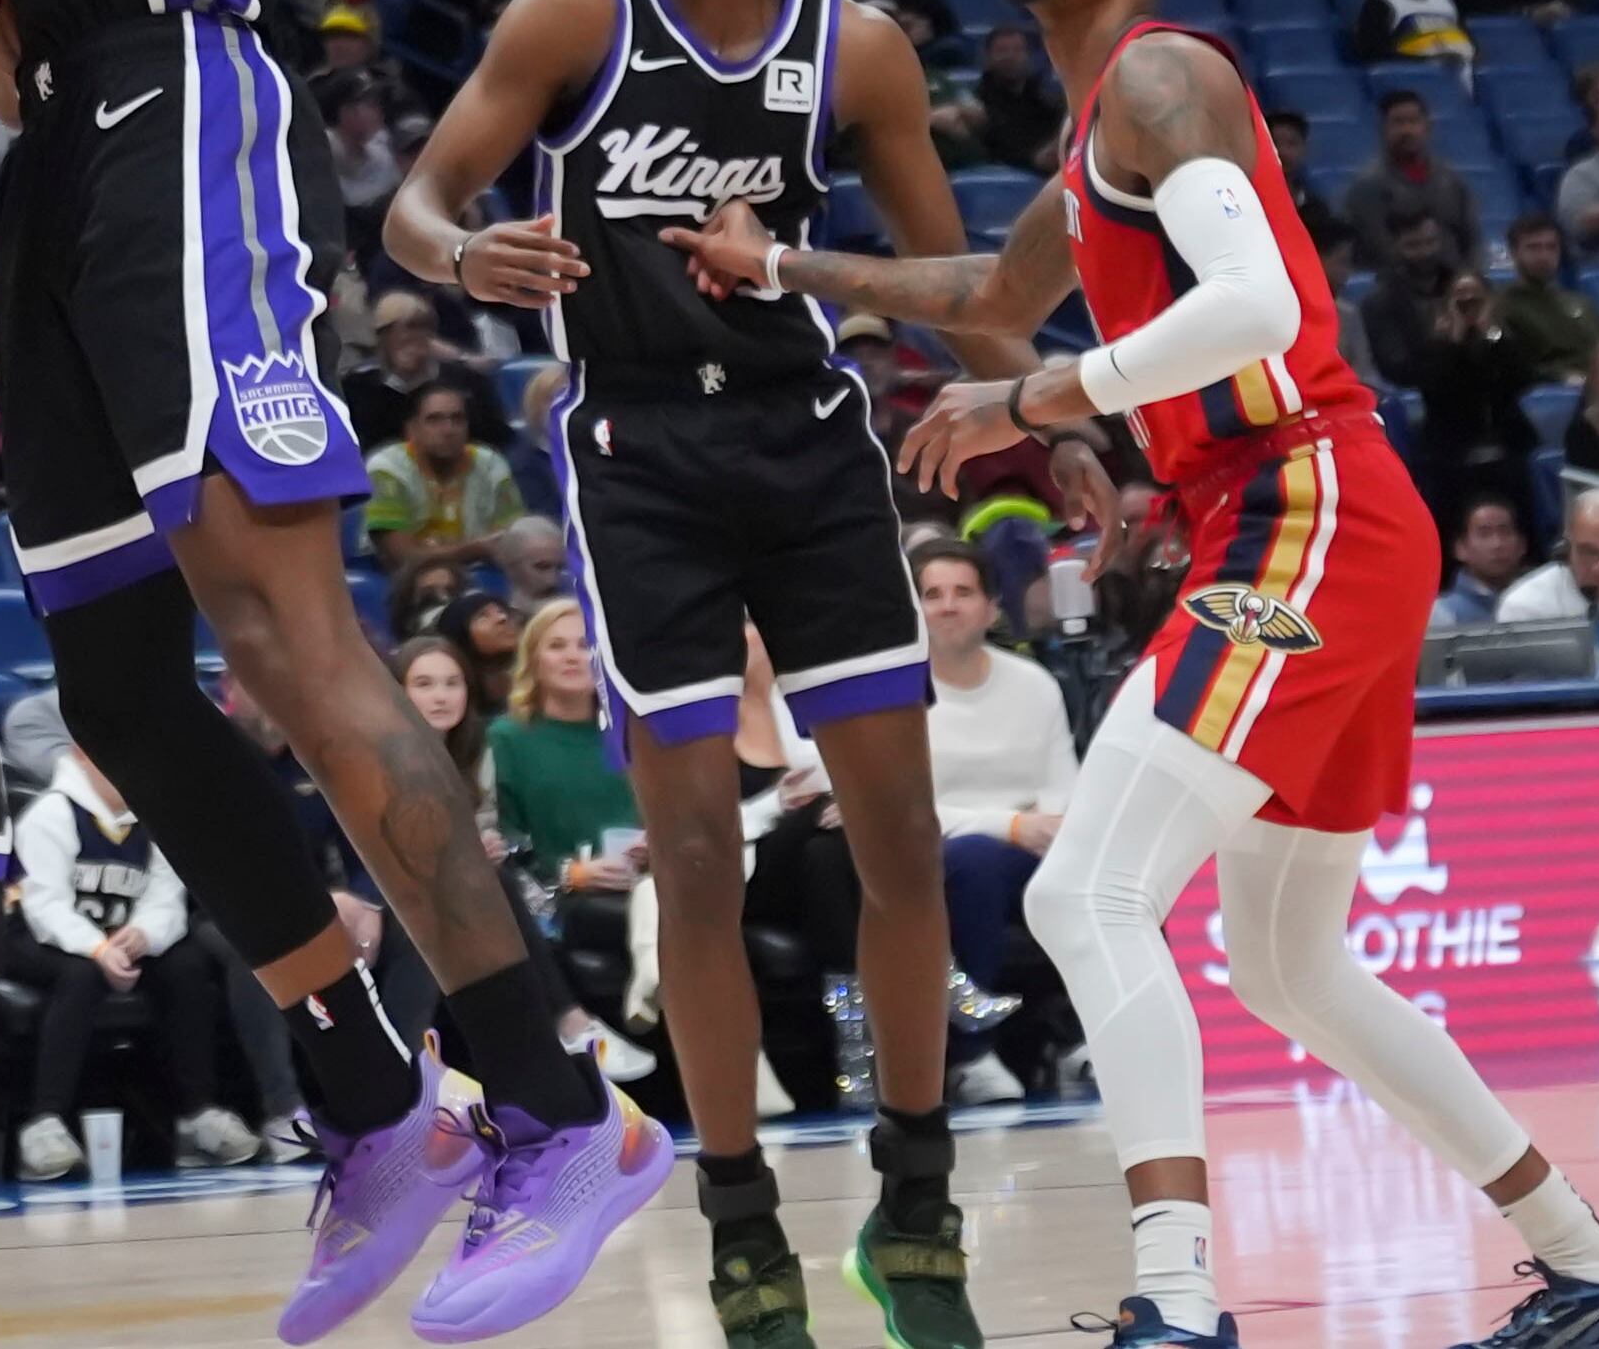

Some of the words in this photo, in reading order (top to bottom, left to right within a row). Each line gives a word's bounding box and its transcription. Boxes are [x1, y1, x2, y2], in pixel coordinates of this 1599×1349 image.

[778, 68, 803, 94] R
[595, 122, 787, 224] Kings
[241, 397, 322, 427] KINGS
